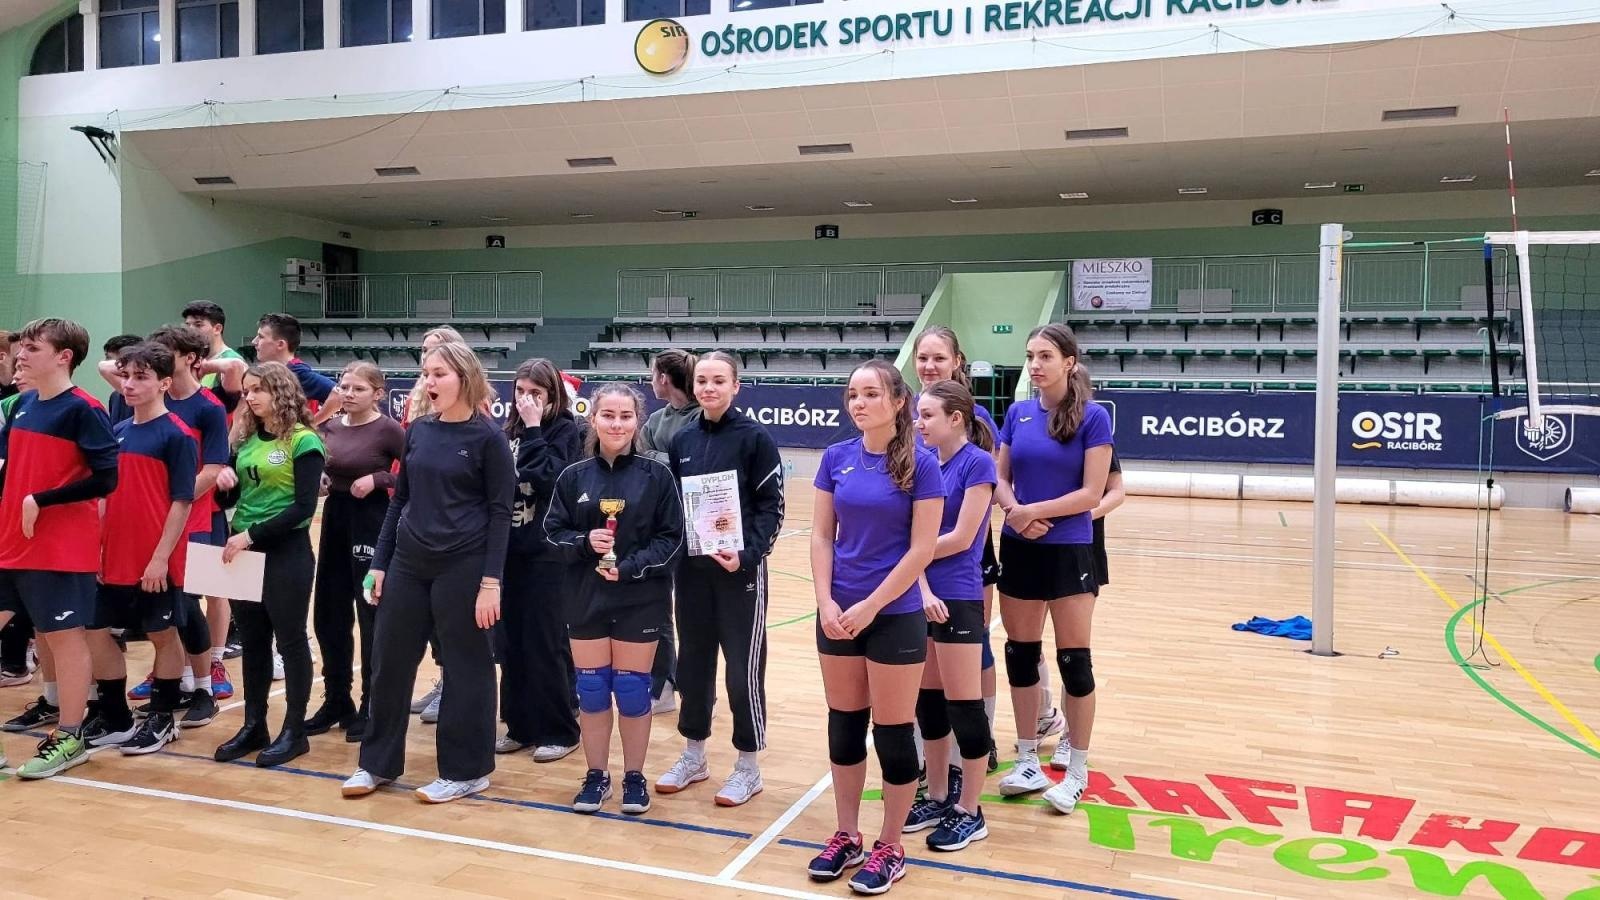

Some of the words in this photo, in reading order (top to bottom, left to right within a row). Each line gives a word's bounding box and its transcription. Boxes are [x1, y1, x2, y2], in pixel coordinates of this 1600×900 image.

[701, 20, 828, 58] OŚRODEK
[839, 8, 953, 45] SPORTU
[965, 7, 972, 34] I
[984, 0, 1151, 32] REKREACJI
[1082, 260, 1143, 274] MIESZKO
[734, 402, 840, 427] ACIBÓRZ
[1141, 411, 1285, 439] RACIBÓRZ
[1387, 440, 1442, 451] RACIBÓRZ
